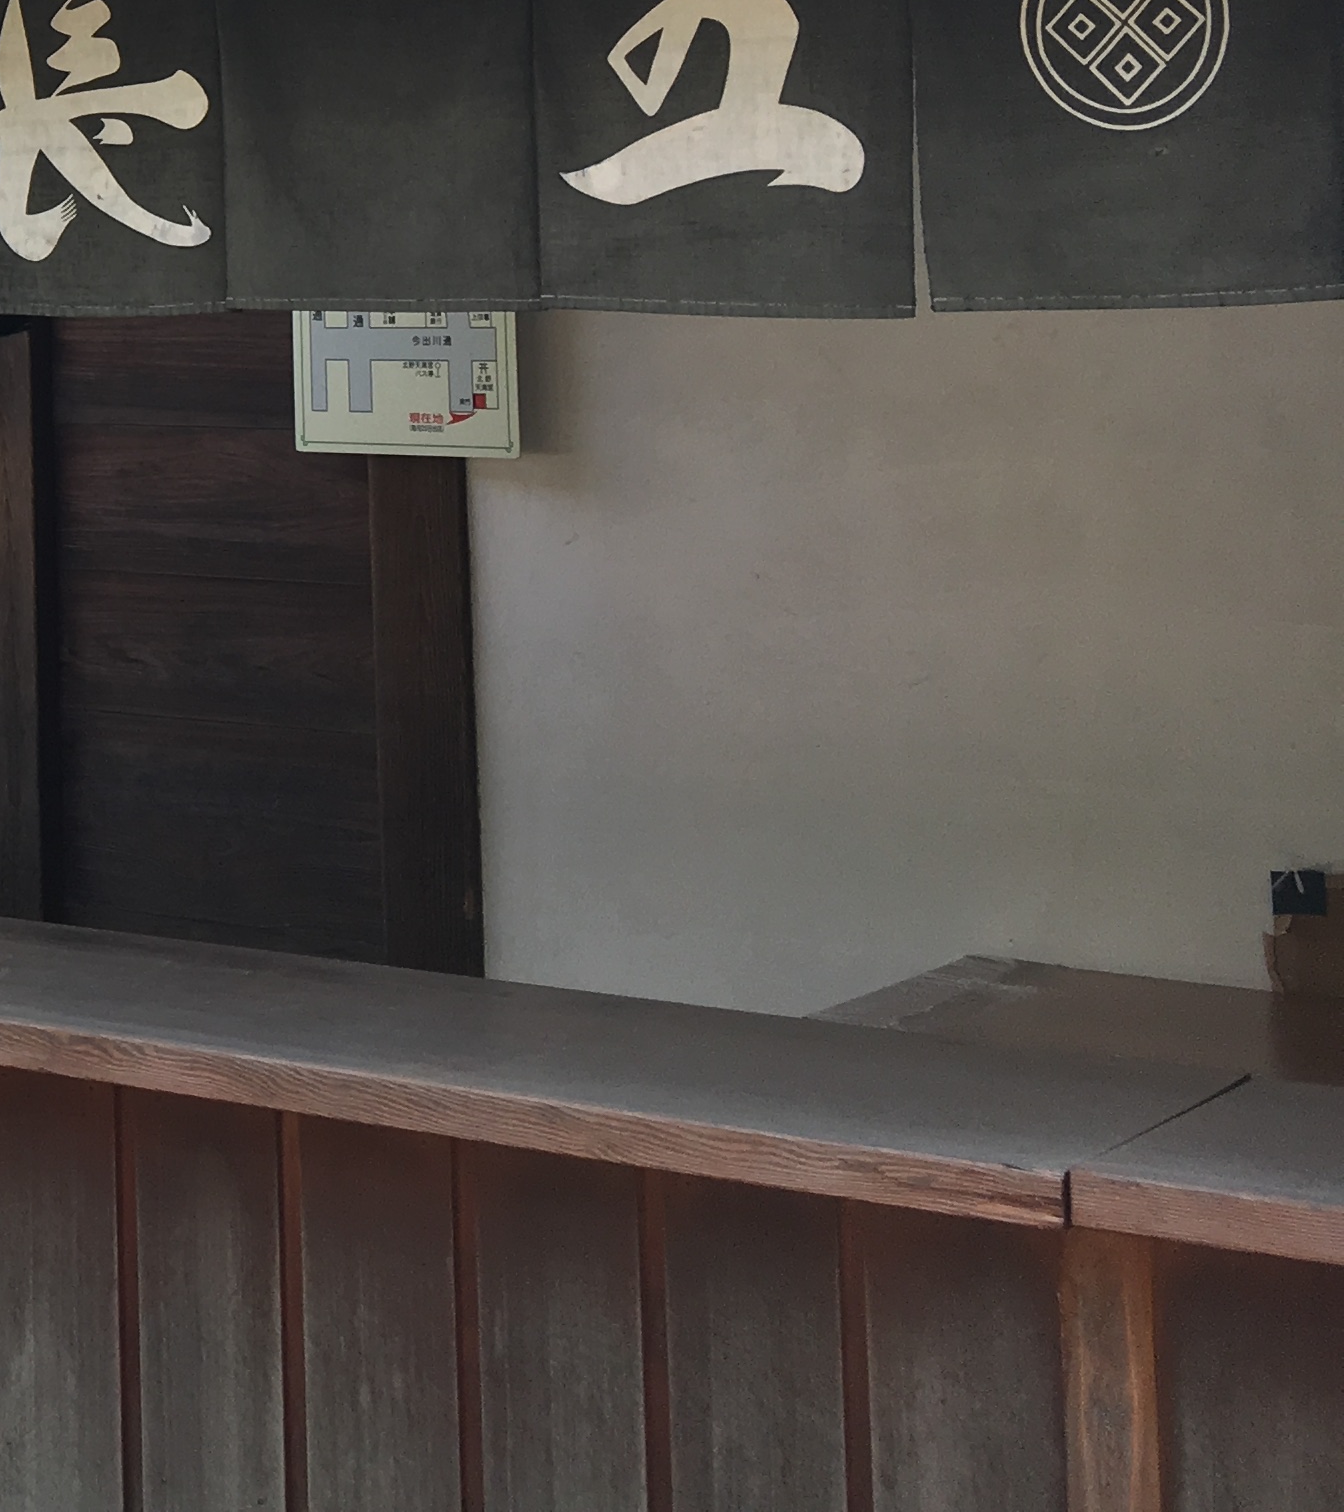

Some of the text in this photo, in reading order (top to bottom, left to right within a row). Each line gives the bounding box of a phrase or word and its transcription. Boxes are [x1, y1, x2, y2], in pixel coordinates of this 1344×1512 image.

[412, 335, 452, 347] 今出川通
[409, 412, 444, 425] 現在地
